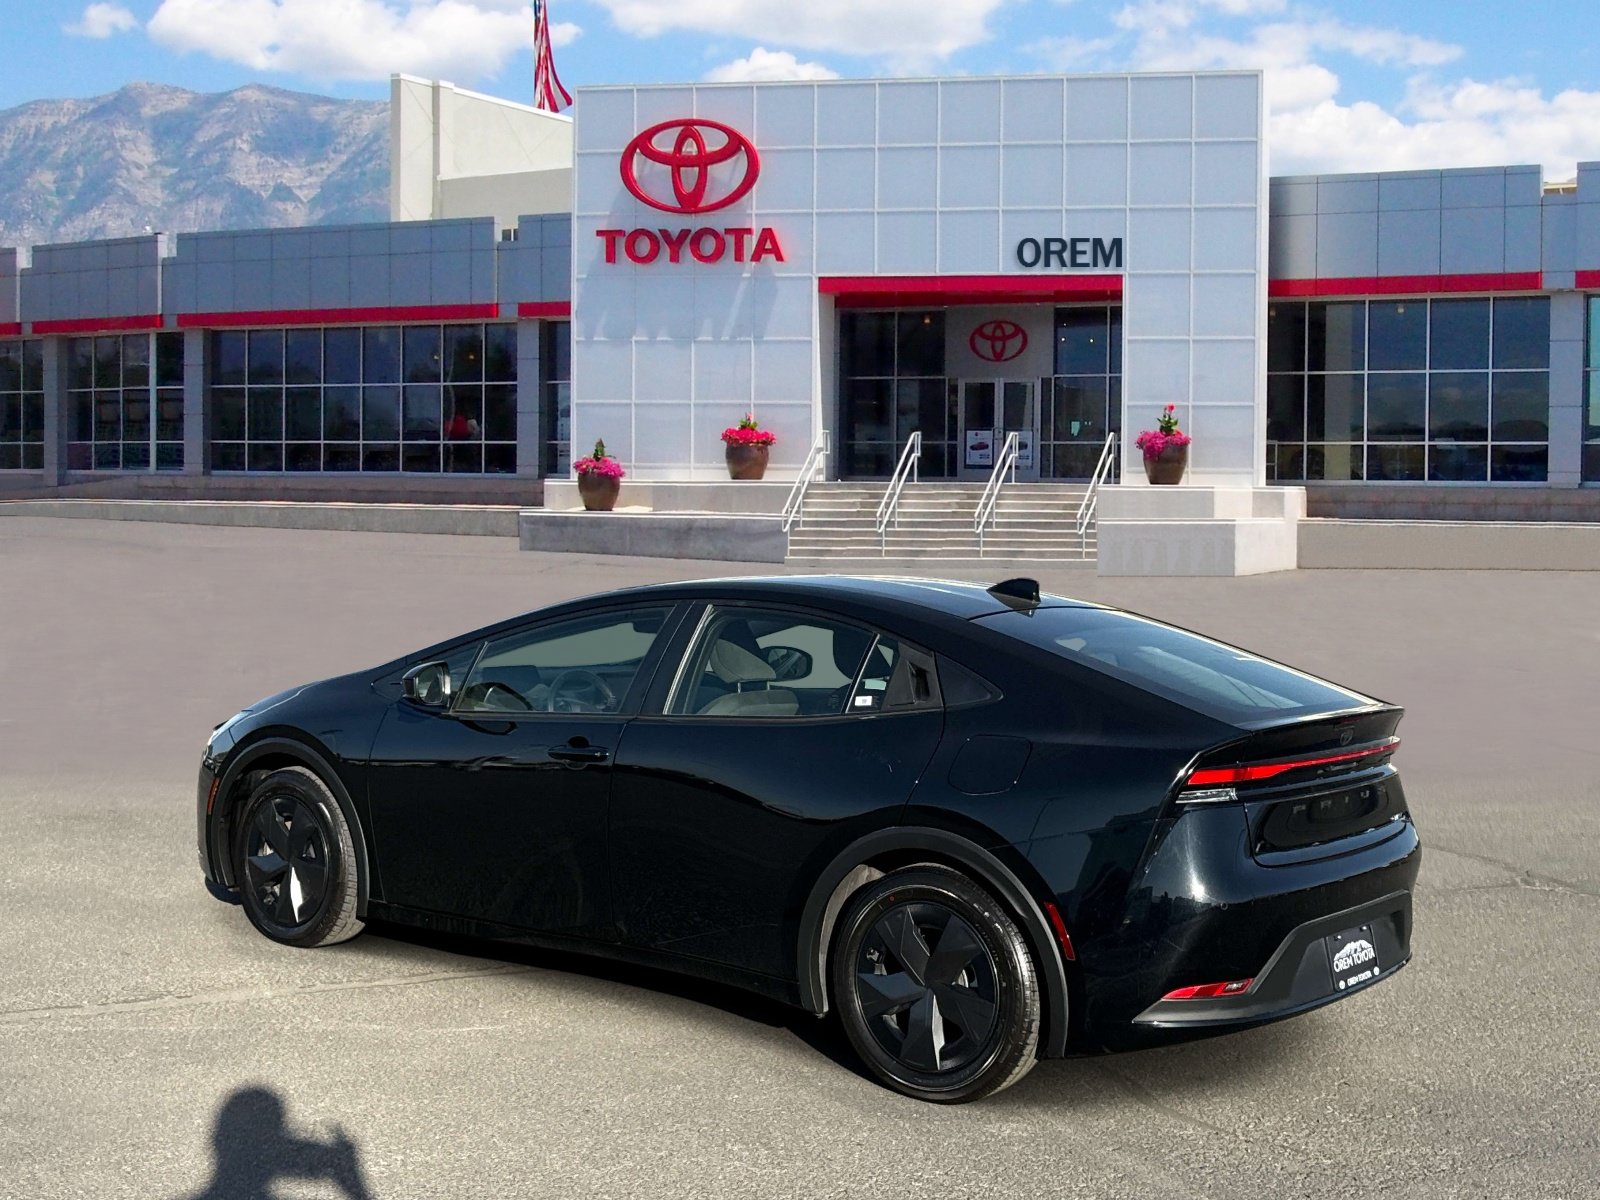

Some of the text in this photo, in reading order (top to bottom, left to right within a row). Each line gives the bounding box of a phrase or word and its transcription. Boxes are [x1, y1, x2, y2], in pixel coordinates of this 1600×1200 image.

[596, 227, 785, 264] TOYOTA
[1016, 237, 1124, 269] OREM
[1333, 947, 1375, 973] OREM TOYOTA
